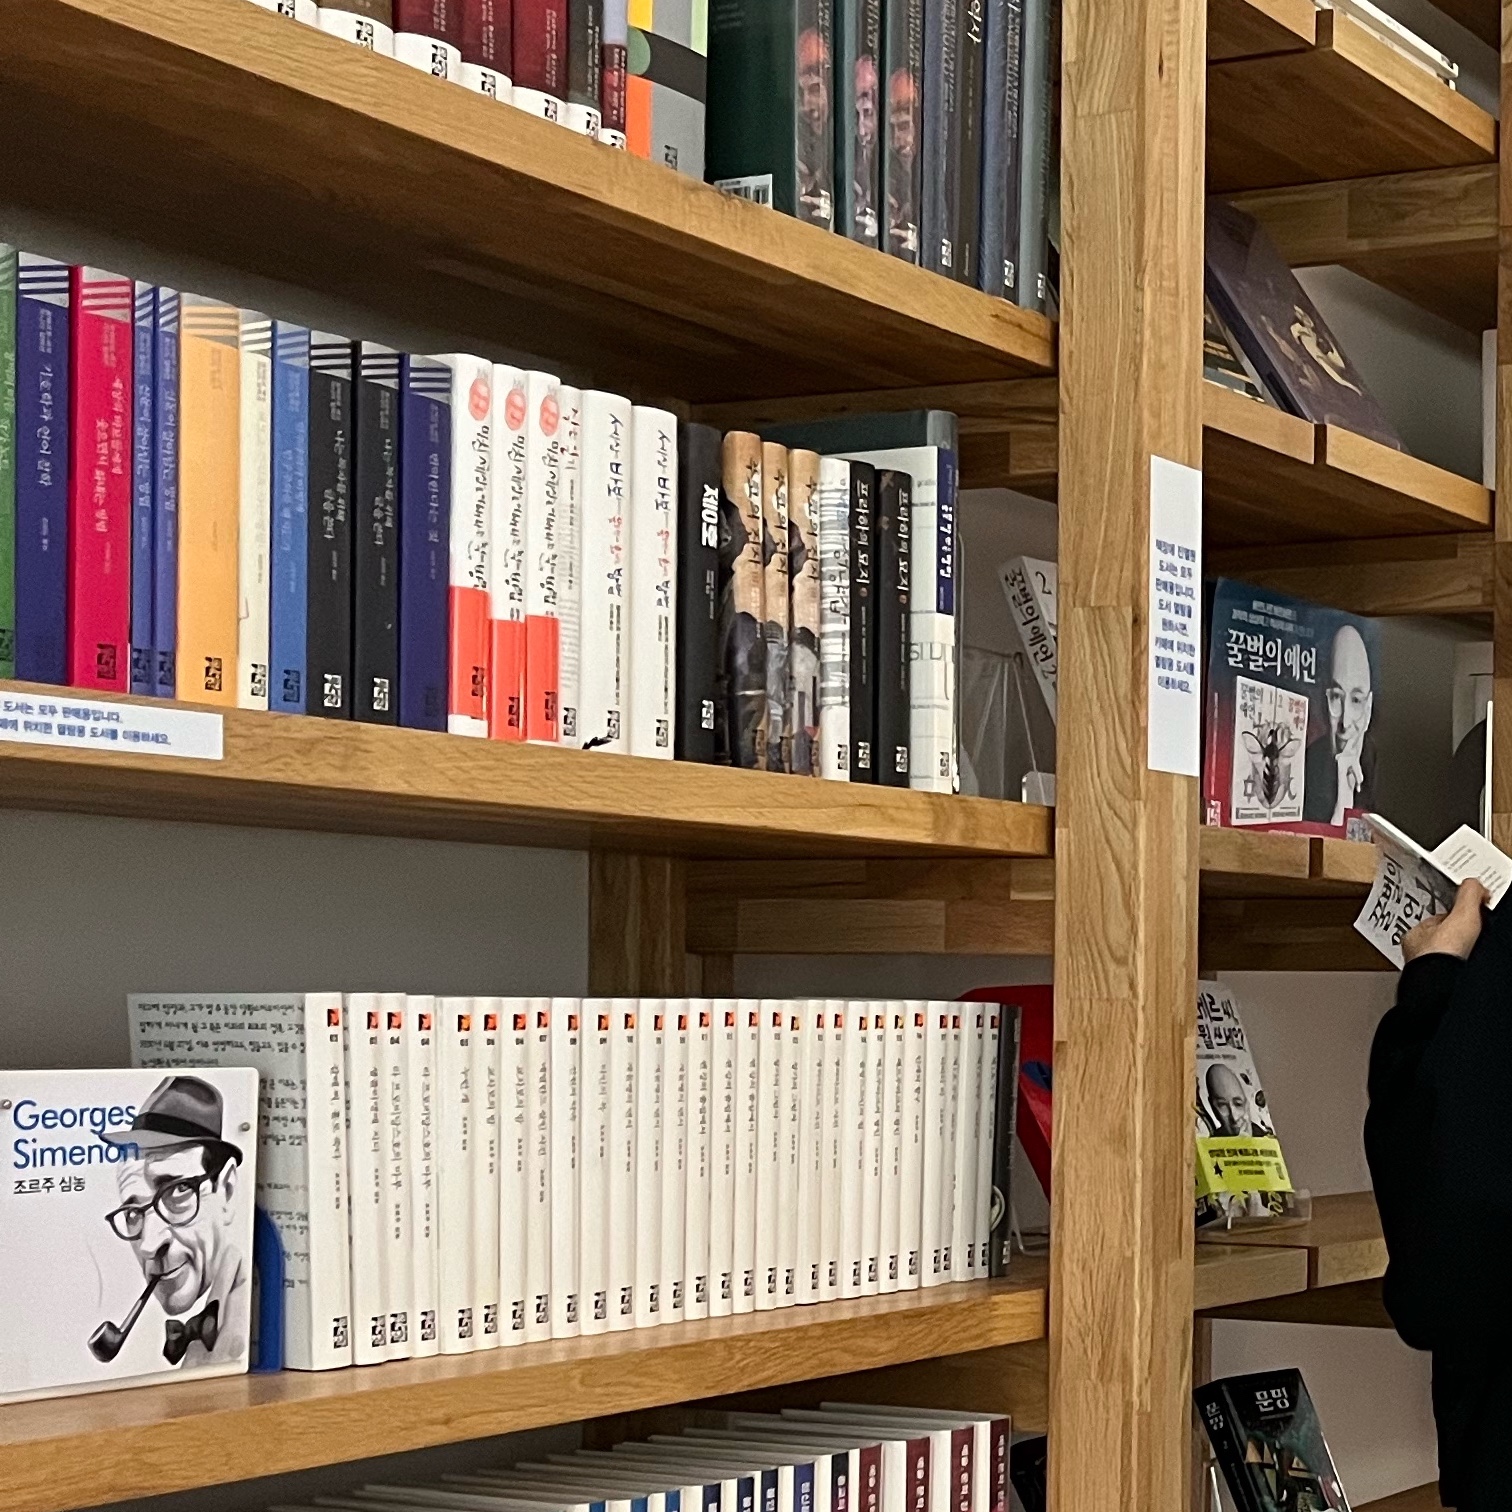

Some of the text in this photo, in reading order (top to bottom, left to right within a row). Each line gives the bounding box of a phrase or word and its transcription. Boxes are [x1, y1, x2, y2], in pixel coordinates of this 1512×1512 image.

[702, 484, 719, 549] 제0호
[1035, 570, 1052, 594] 2
[1226, 628, 1317, 684] 꿀벌의 예언
[13, 1099, 136, 1139] Georges
[13, 1138, 140, 1170] Simenon
[13, 1175, 86, 1195] 조르주 심농
[1255, 1386, 1290, 1412] 문명
